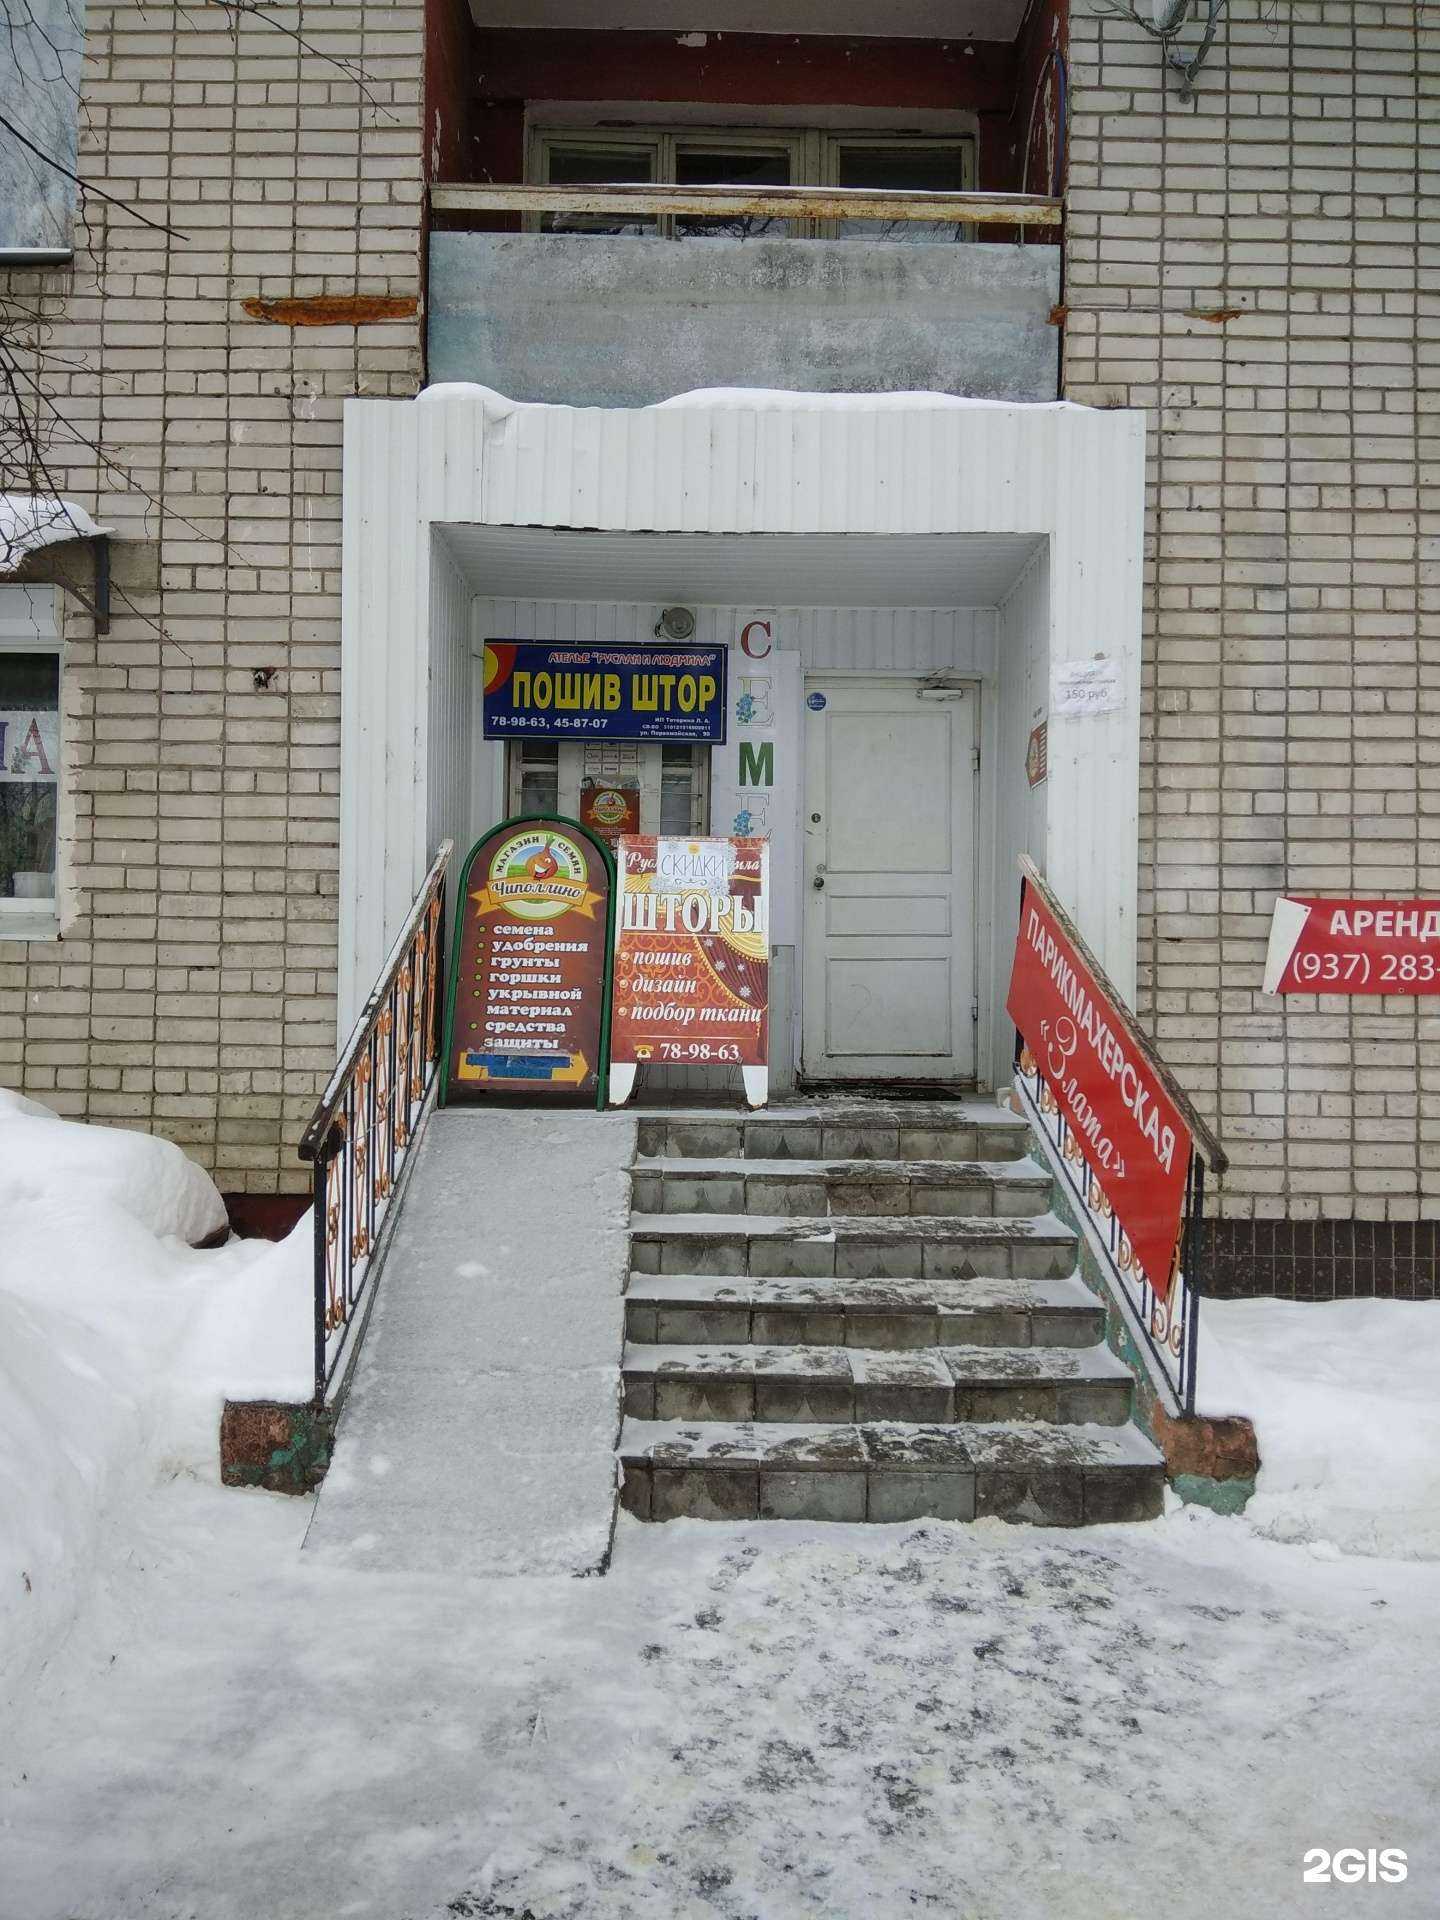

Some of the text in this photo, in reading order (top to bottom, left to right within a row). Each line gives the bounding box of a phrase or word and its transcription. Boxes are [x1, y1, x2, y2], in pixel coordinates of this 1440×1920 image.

[548, 651, 590, 664] АТЕЛЬЕ
[642, 655, 651, 665] И
[513, 671, 716, 712] ПОШИВ ШТОР
[491, 716, 609, 729] 78-98-63, 45-87-07
[496, 836, 582, 874] МАГАЗИН СЕМЯН
[661, 854, 724, 877] СКИДКИ
[492, 882, 581, 898] Чиполлино
[623, 892, 768, 933] ШТОРЫ
[493, 925, 554, 936] семена
[492, 940, 588, 953] удобрения
[490, 956, 560, 969] грунты
[633, 950, 692, 966] пошив
[1293, 952, 1370, 984] (937)
[489, 973, 561, 985] горшки
[632, 974, 697, 994] дизайн
[488, 987, 582, 1001] укрывной
[487, 1006, 573, 1017] материал
[630, 1003, 762, 1025] подбор ткани
[485, 1021, 567, 1035] средства
[484, 1037, 559, 1050] защиты
[1027, 907, 1176, 1176] ПАРИКМАХЕРСКАЯ
[660, 1043, 739, 1060] 78-98-63
